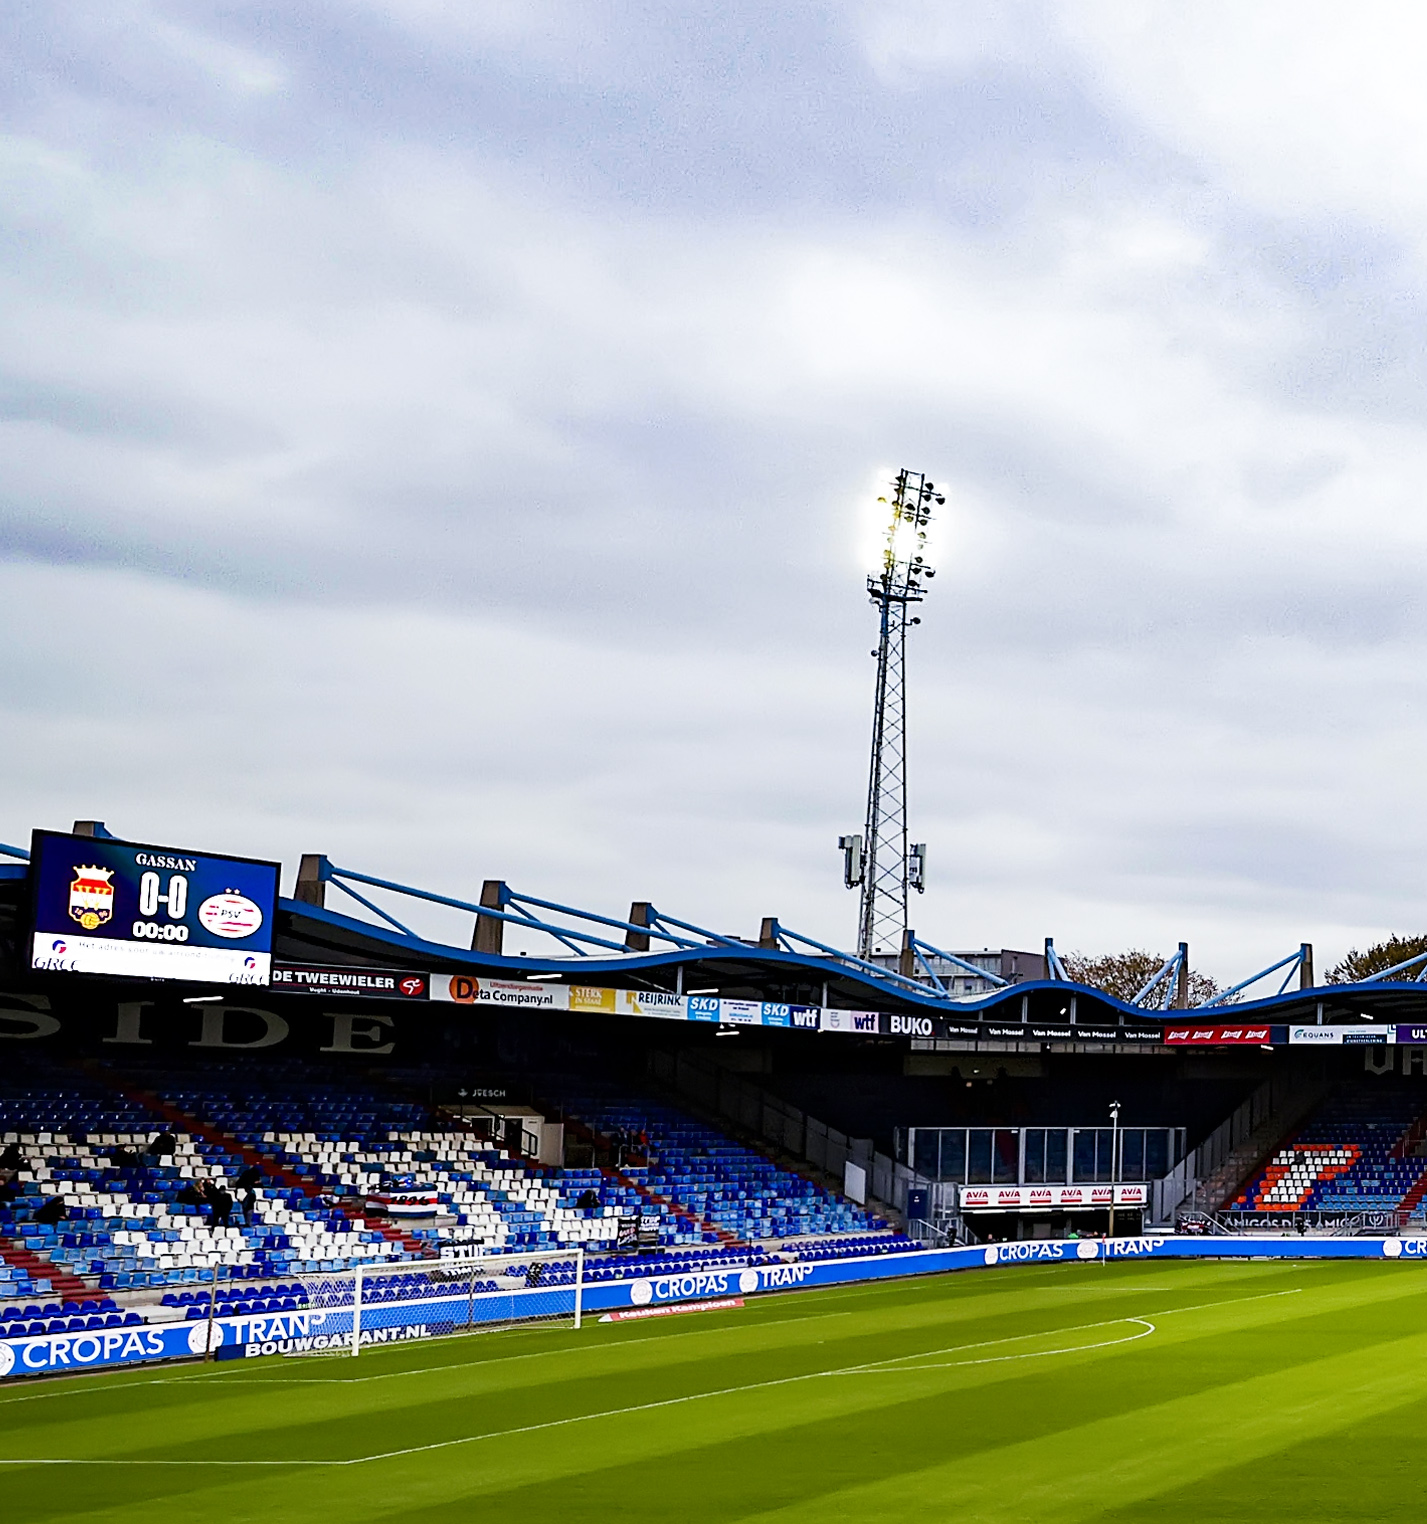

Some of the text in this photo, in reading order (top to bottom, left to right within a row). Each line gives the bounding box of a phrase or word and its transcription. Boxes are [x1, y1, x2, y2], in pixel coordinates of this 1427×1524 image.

[135, 853, 196, 872] GASSAN
[139, 871, 188, 919] 0-0
[132, 921, 189, 941] 00:00
[272, 969, 395, 989] DE TWEEWIELER
[457, 976, 553, 1005] Deta Company.nl
[639, 992, 681, 1006] REIJRINK
[690, 997, 719, 1011] SKD
[763, 1003, 789, 1017] SKD
[793, 1010, 818, 1028] wtf
[854, 1013, 876, 1031] wtf
[949, 1026, 978, 1035] Van Mossel
[989, 1028, 1024, 1036] Van Mossel
[1033, 1028, 1071, 1038] Van Mossel
[1078, 1030, 1116, 1039] Van Mossel
[1125, 1031, 1138, 1039] Van
[1139, 1031, 1161, 1040] Mossel
[1302, 1031, 1334, 1039] EQUANS
[1000, 1242, 1063, 1261] CROPAS
[655, 1276, 728, 1298] CROPAS
[22, 1330, 165, 1368] CROPAS
